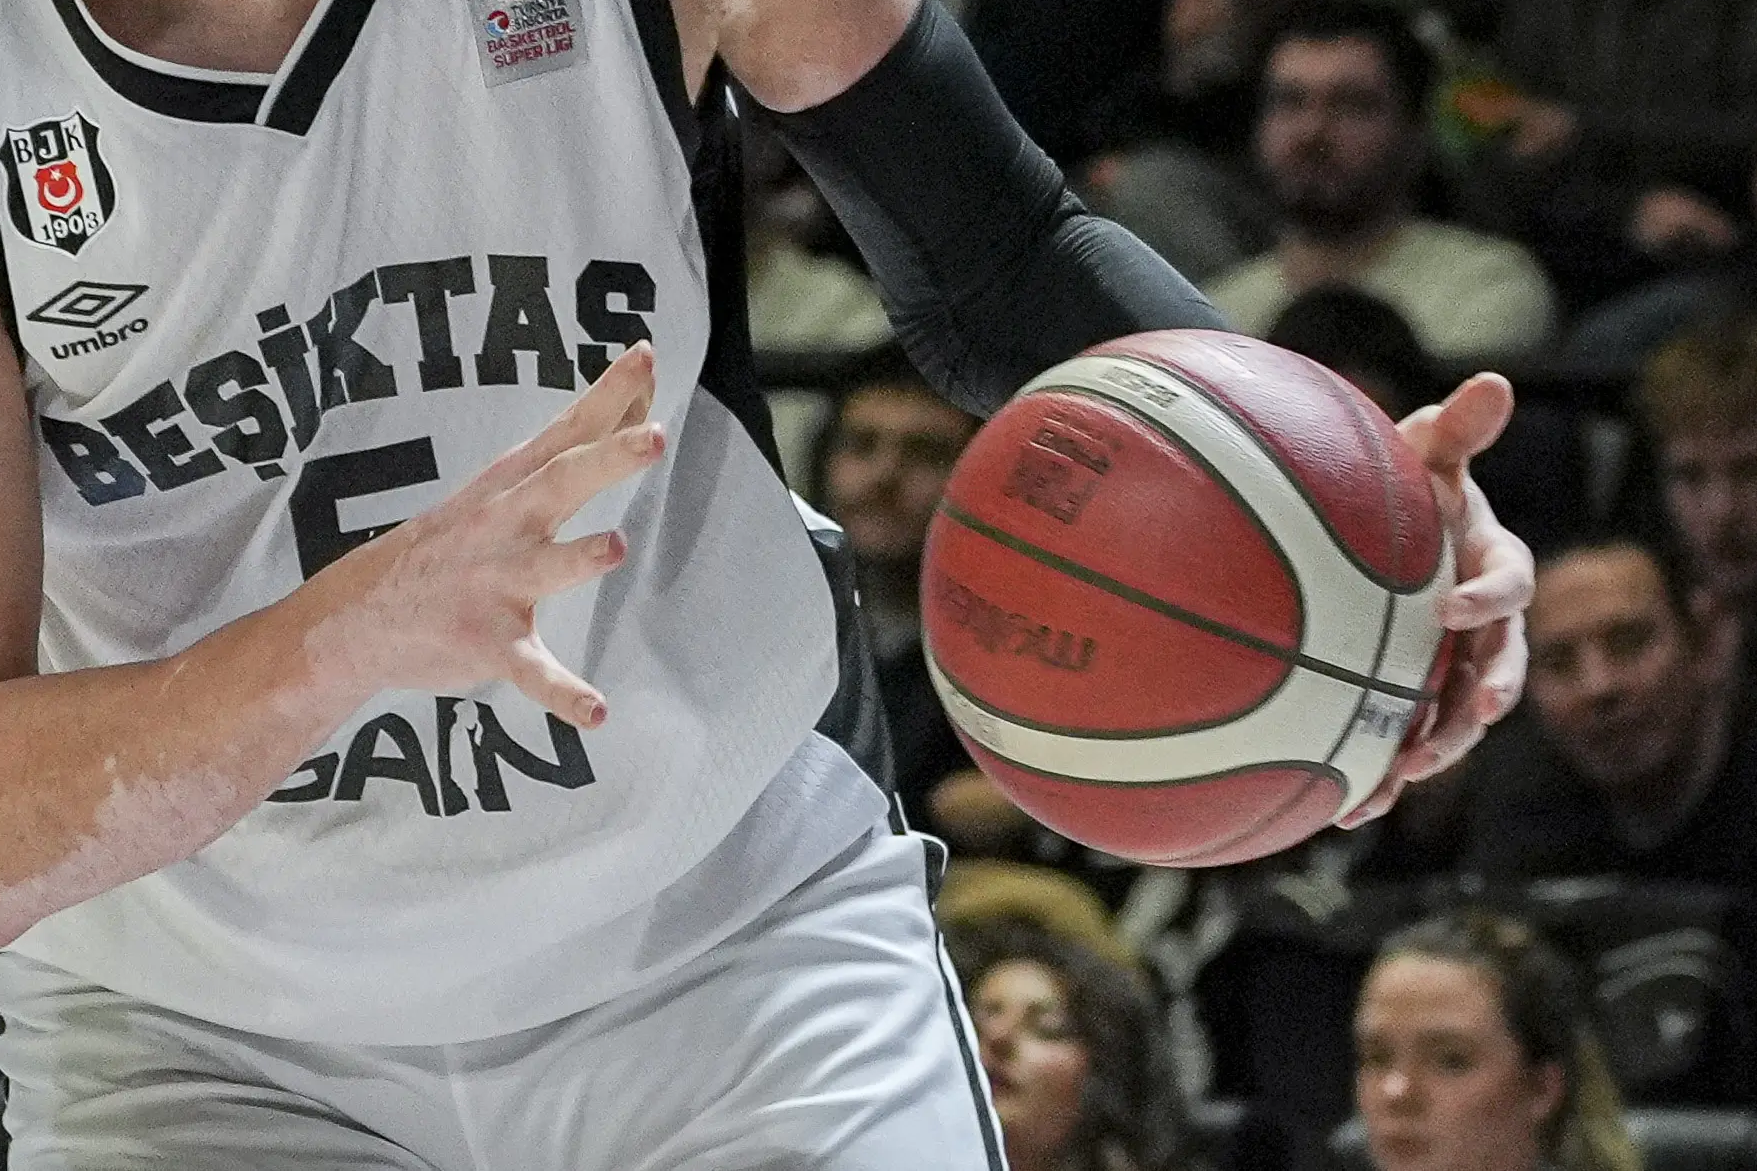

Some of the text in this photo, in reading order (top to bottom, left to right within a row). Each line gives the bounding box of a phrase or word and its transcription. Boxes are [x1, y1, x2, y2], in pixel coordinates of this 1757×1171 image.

[12, 124, 84, 164] BJK
[40, 211, 100, 242] 1903
[50, 318, 149, 360] umbro
